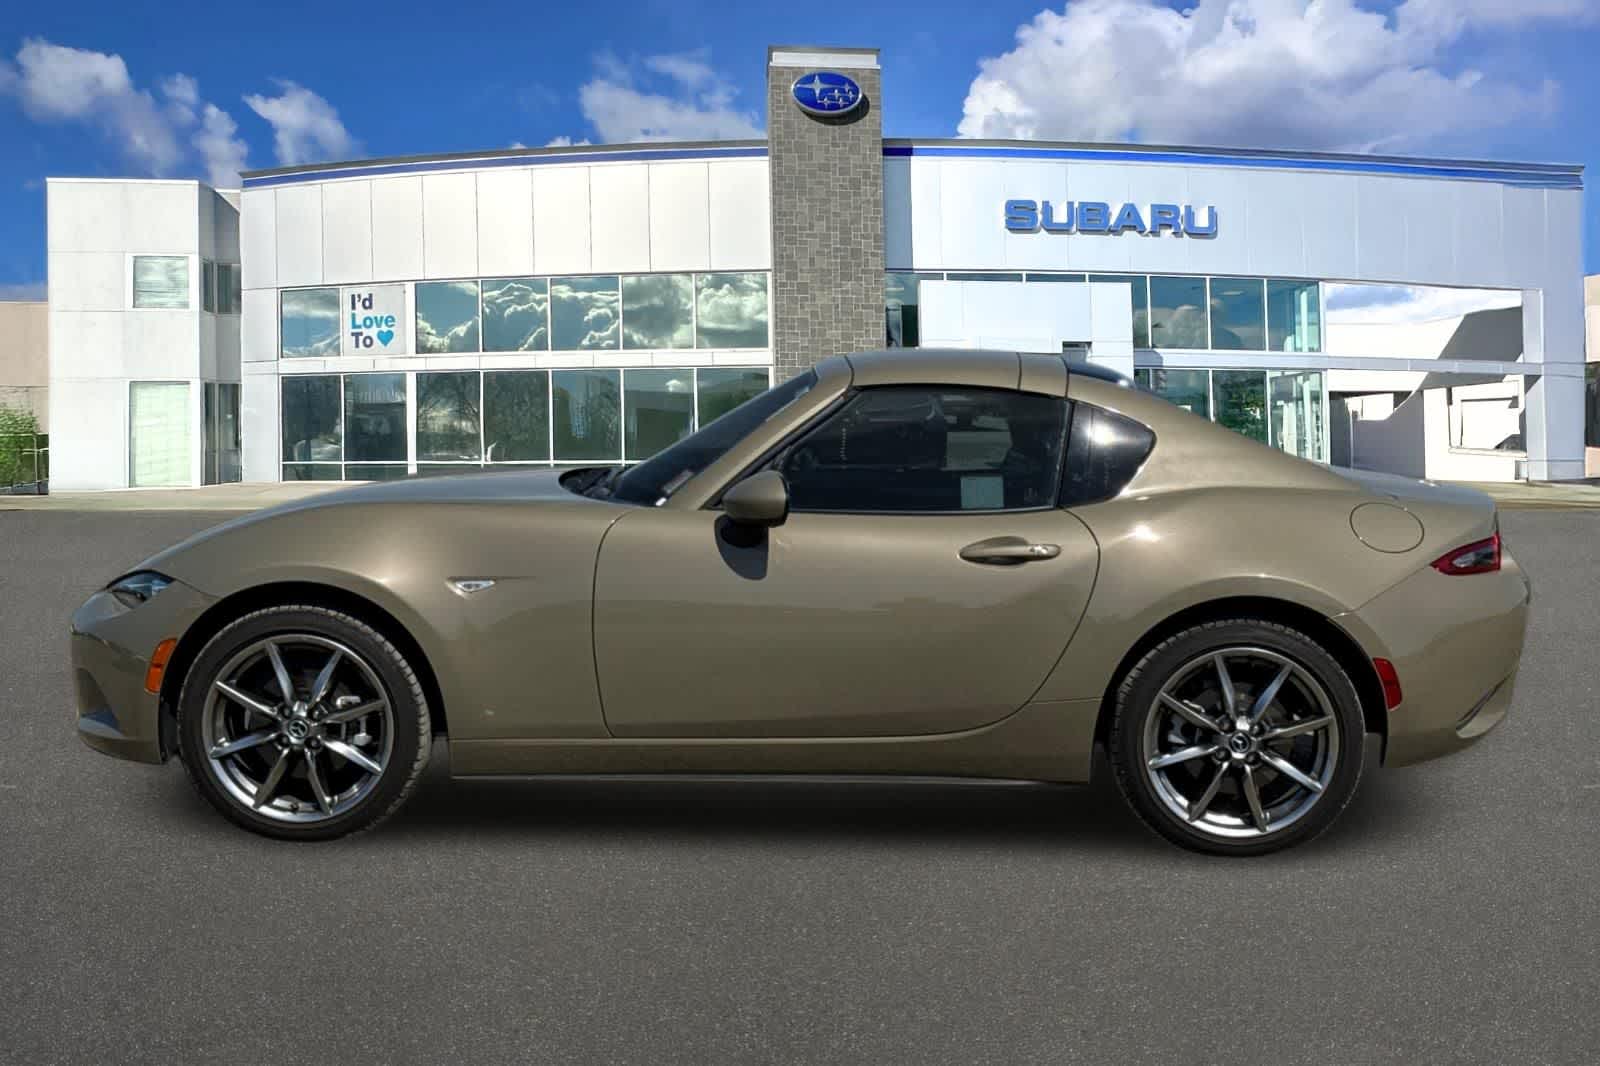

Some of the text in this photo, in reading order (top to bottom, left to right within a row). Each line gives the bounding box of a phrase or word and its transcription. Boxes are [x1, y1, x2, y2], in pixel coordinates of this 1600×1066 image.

[1005, 200, 1217, 237] SUBARU
[351, 313, 396, 329] Love
[351, 331, 374, 348] To
